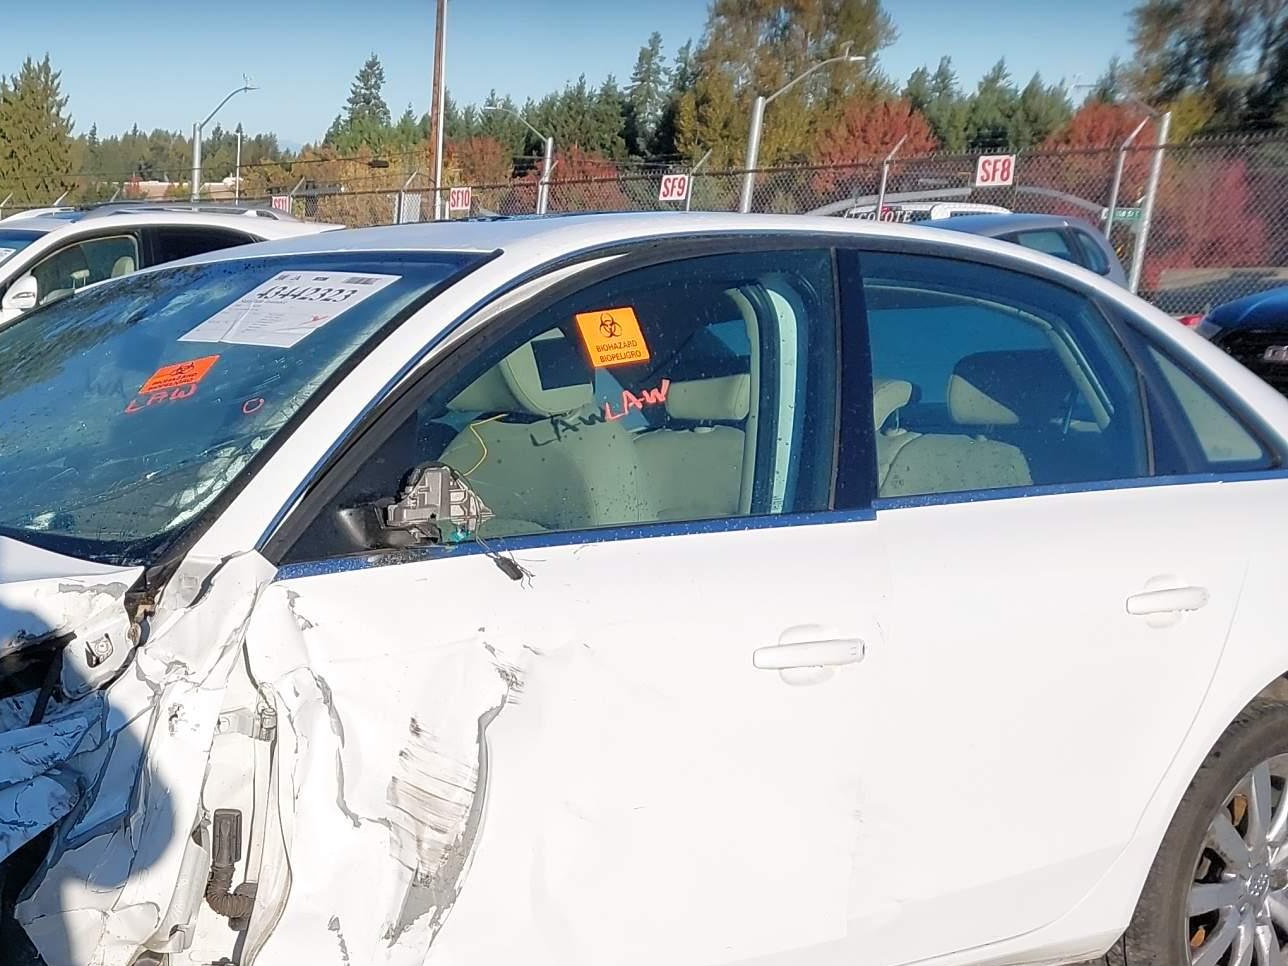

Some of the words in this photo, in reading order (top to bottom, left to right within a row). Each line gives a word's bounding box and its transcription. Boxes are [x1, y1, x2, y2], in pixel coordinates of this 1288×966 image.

[980, 158, 1012, 183] SF8
[662, 175, 687, 198] SF9
[451, 189, 471, 208] SF10
[257, 285, 358, 302] 43442323
[596, 339, 638, 353] BIOHAZARD
[599, 350, 642, 363] BIOPELIGRO
[604, 377, 670, 421] LAW
